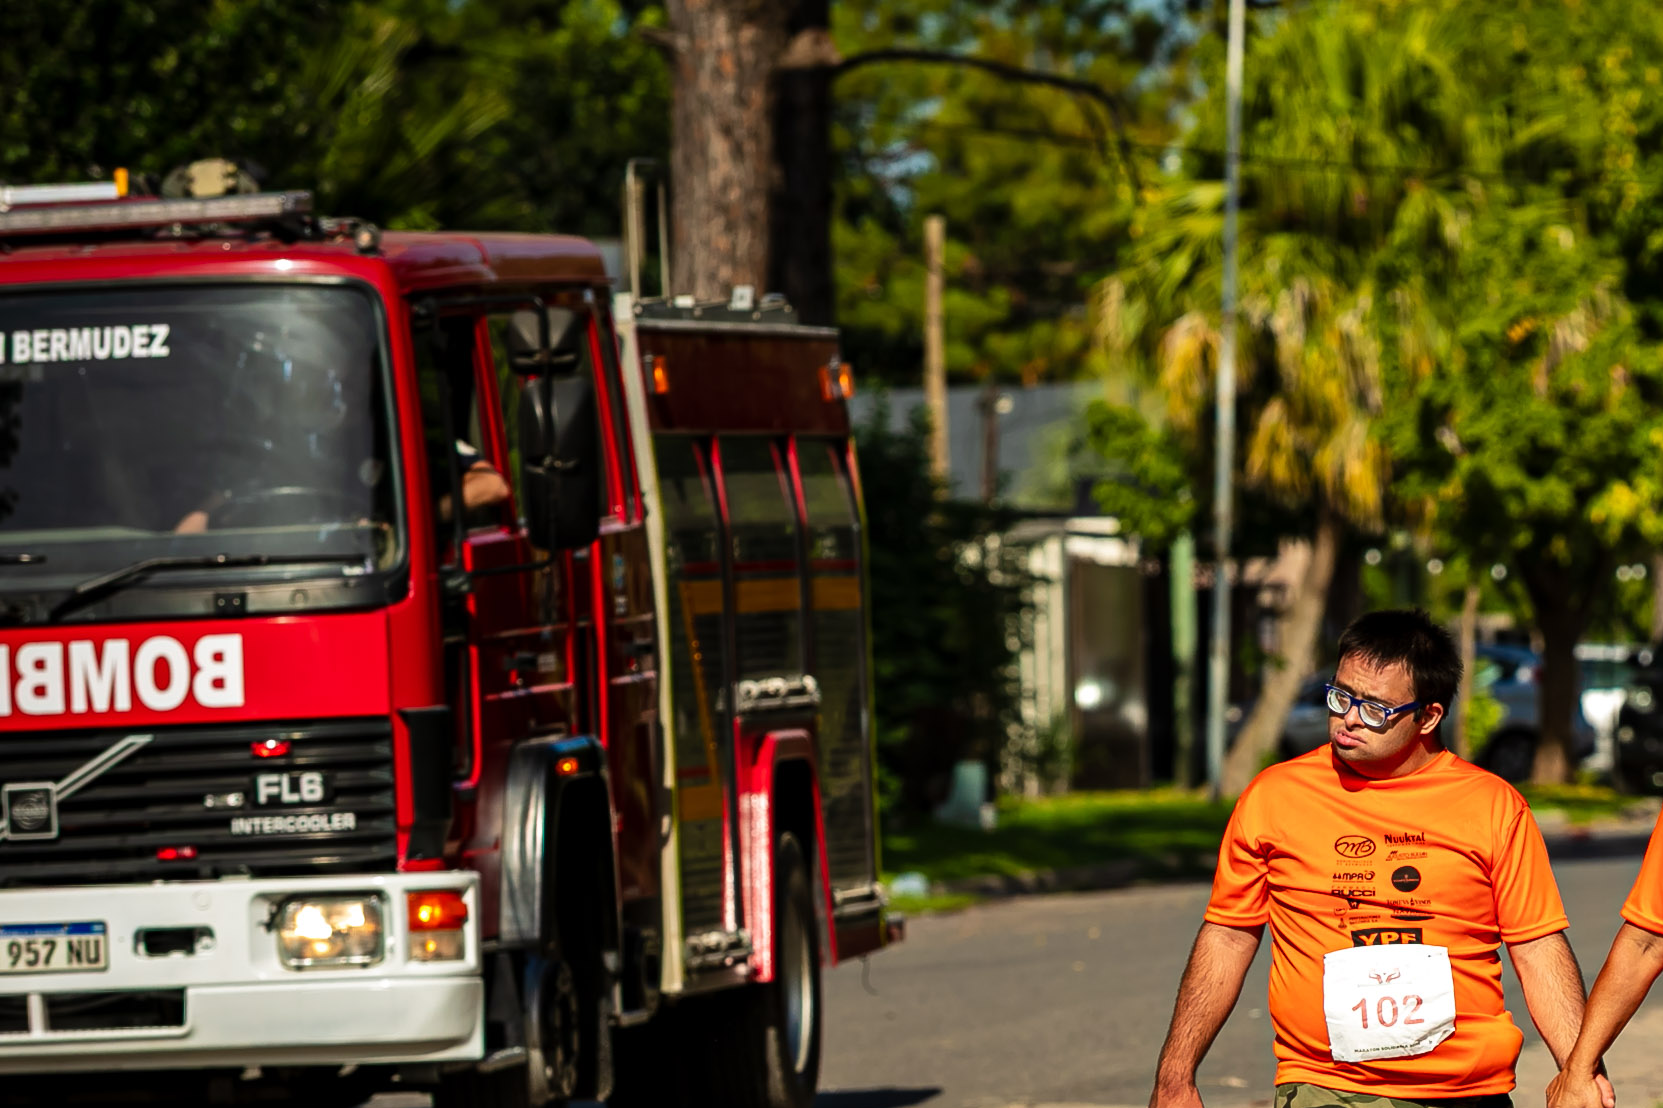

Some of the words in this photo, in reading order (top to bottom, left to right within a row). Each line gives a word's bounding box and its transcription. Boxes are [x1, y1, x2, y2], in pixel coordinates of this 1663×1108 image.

[12, 323, 170, 364] BERMUDEZ
[257, 772, 324, 805] FL6
[231, 813, 356, 835] INTERCOOLER
[7, 939, 57, 967] 957
[66, 939, 101, 965] NU
[1352, 994, 1425, 1029] 102
